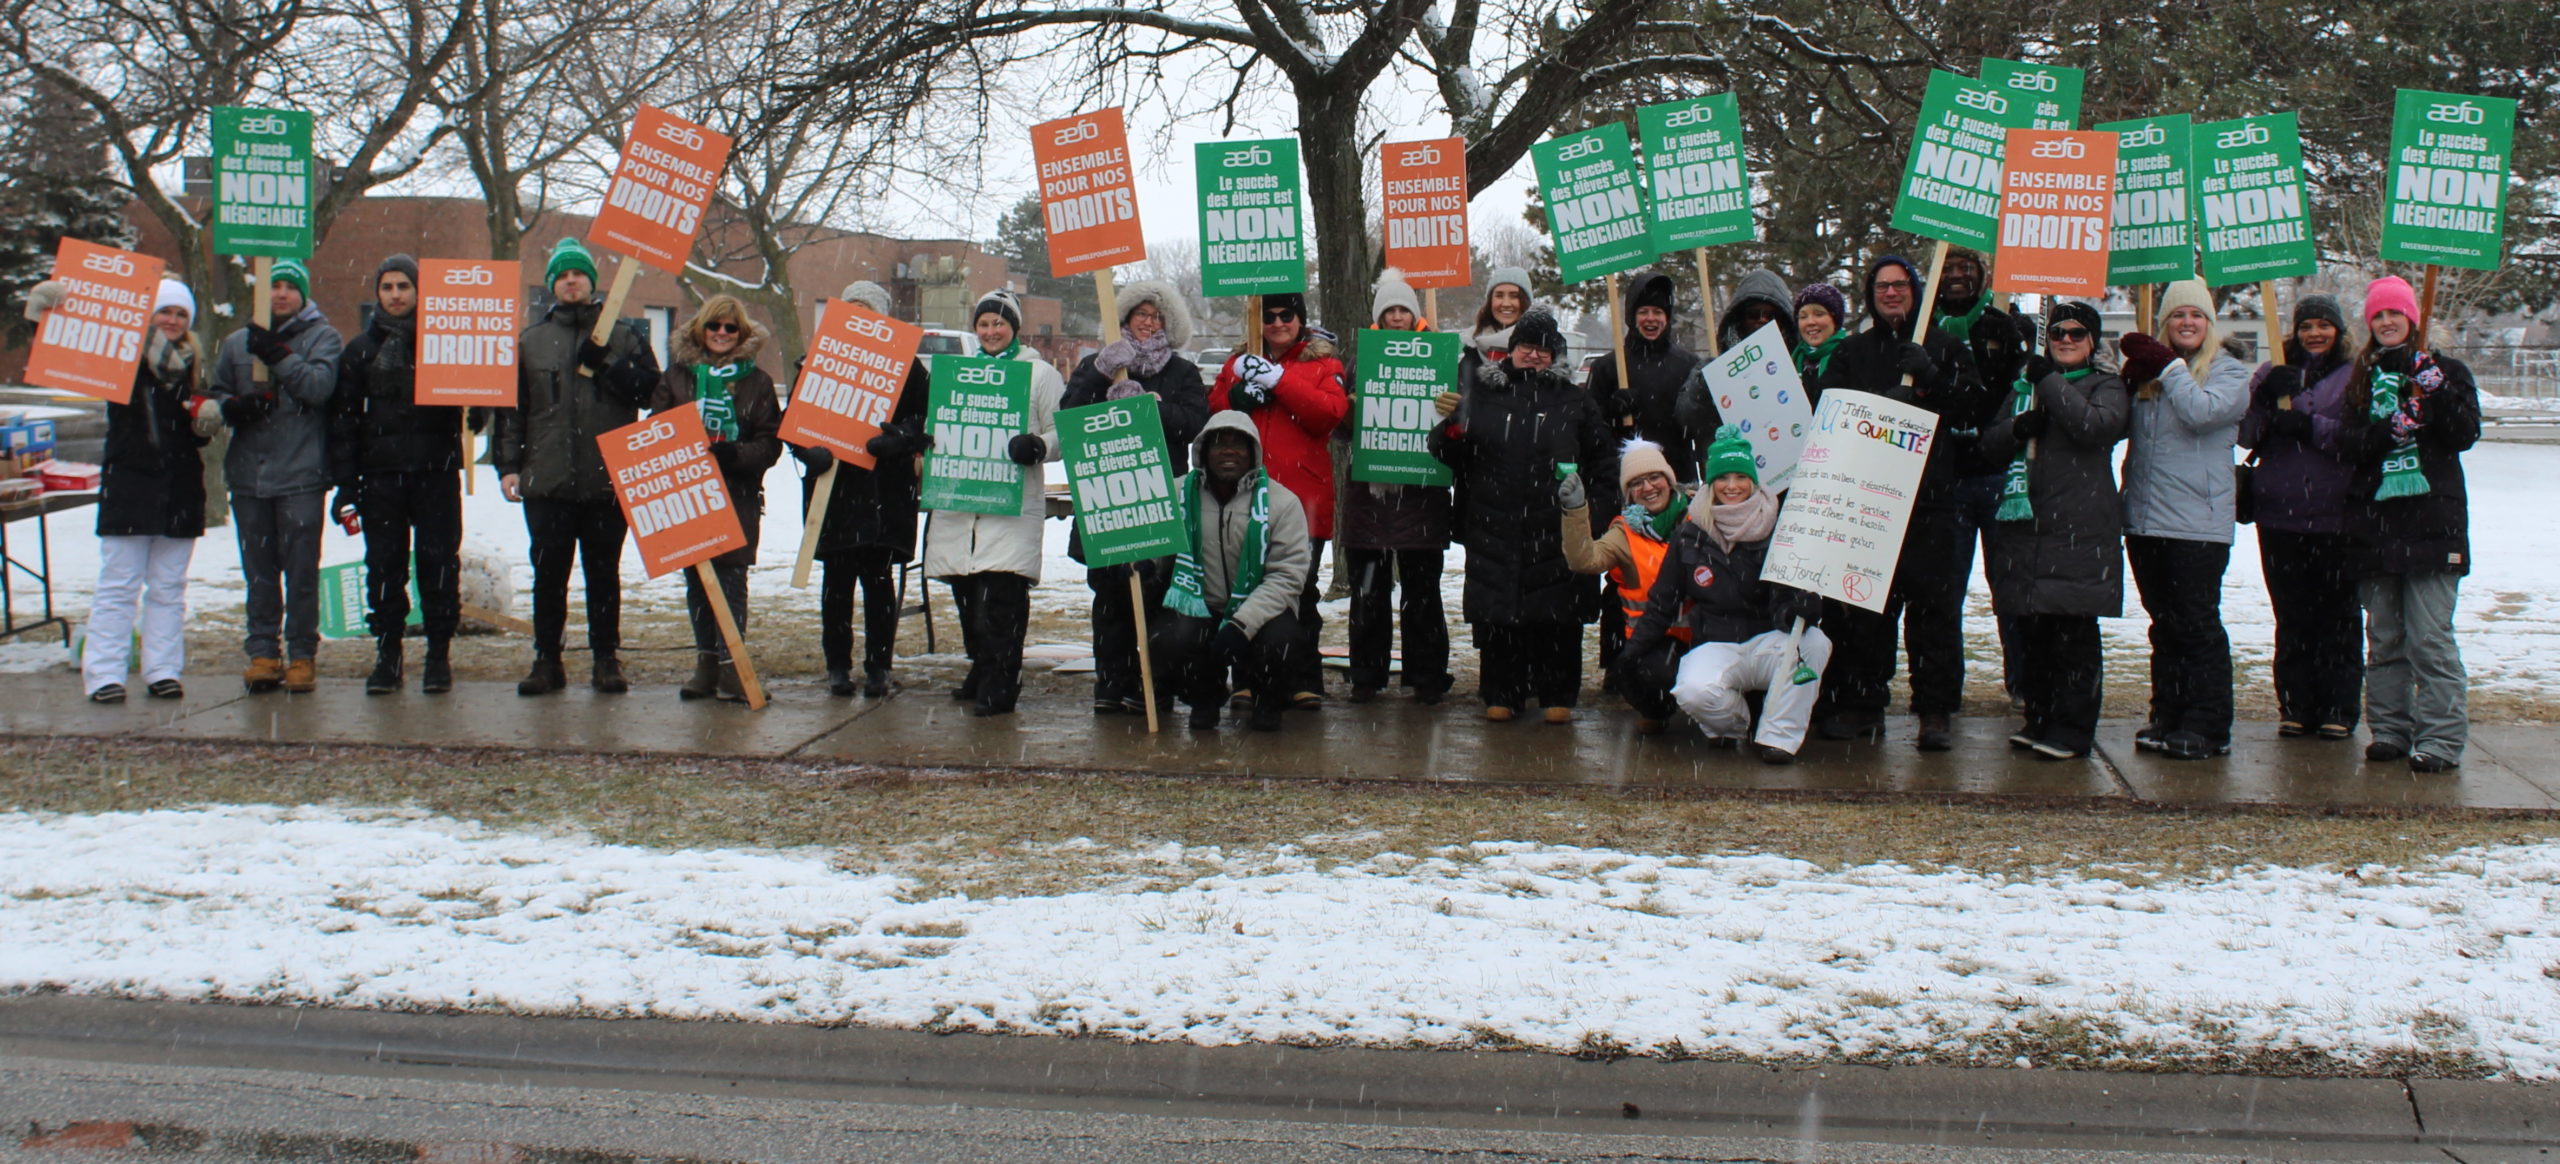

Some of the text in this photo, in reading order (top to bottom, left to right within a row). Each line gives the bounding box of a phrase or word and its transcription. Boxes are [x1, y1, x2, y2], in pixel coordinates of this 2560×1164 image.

[2037, 101, 2059, 117] cès
[1664, 130, 1721, 150] Le succès
[1926, 124, 1950, 143] des
[1952, 131, 1993, 154] élèves
[1944, 110, 2007, 140] Le succès
[235, 140, 291, 158] Le succès
[1653, 142, 1736, 168] des élèves est
[2420, 129, 2487, 152] Le succès
[222, 155, 304, 173] des élèves est
[630, 142, 714, 185] ENSEMBLE
[1042, 148, 1124, 178] ENSEMBLE
[1559, 160, 1615, 184] Le succès
[1916, 142, 2004, 195] NON
[2115, 154, 2171, 174] Le succès
[2215, 152, 2279, 174] Le succès
[2402, 146, 2501, 171] des élèves est
[221, 172, 304, 206] NON
[624, 159, 706, 202] POUR NOS
[1046, 167, 1126, 198] POUR NOS
[1220, 174, 1278, 191] Le succès
[1388, 176, 1460, 195] ENSEMBLE
[1551, 169, 1631, 202] des élèves est
[1654, 158, 1741, 200] NON
[2009, 172, 2106, 191] ENSEMBLE
[2127, 168, 2184, 190] élèves est
[2203, 166, 2296, 192] des élèves est
[2397, 166, 2500, 208] NON
[610, 177, 700, 235] DROITS
[1048, 188, 1133, 234] DROITS
[1207, 189, 1293, 208] des élèves est
[1389, 195, 1460, 214] POUR NOS
[1554, 185, 1640, 232] NON
[1658, 191, 1744, 221] NÉGOCIABLE
[2008, 192, 2103, 212] POUR NOS
[2110, 188, 2186, 228] NON
[2204, 185, 2301, 228] NON
[220, 203, 305, 227] NÉGOCIABLE
[1207, 207, 1295, 241] NON
[2394, 201, 2497, 234] NÉGOCIABLE
[1389, 215, 1464, 249] DROITS
[1561, 216, 1646, 253] NÉGOCIABLE
[2003, 214, 2103, 251] DROITS
[2209, 221, 2305, 252] NÉGOCIABLE
[1208, 241, 1297, 264] NÉGOCIABLE
[66, 298, 144, 327] OUR NOS
[426, 297, 514, 312] ENSEMBLE
[43, 314, 141, 362] DROITS
[426, 315, 513, 331] POUR NOS
[424, 334, 514, 366] DROITS
[819, 336, 904, 376] ENSEMBLE
[812, 354, 896, 393] POUR NOS
[1379, 364, 1436, 381] Le succès
[799, 372, 891, 427] DROITS
[951, 391, 1008, 410] Le succès
[1366, 379, 1386, 394] des
[1390, 381, 1426, 397] élèves
[937, 406, 1020, 426] des élèves est
[1842, 402, 1872, 419] J'offre
[1879, 414, 1896, 424] une
[935, 424, 1020, 460] NON
[1083, 435, 1143, 458] Le succès
[1361, 428, 1429, 453] NÉGOCIA
[618, 442, 707, 484] ENSEMBLE
[931, 455, 1017, 483] NÉGOCIABLE
[1075, 447, 1160, 477] des élèves est
[626, 460, 713, 503] POUR NOS
[1077, 466, 1168, 512] NON
[632, 479, 726, 537] DROITS
[1084, 501, 1174, 535] NÉGOCIABLE
